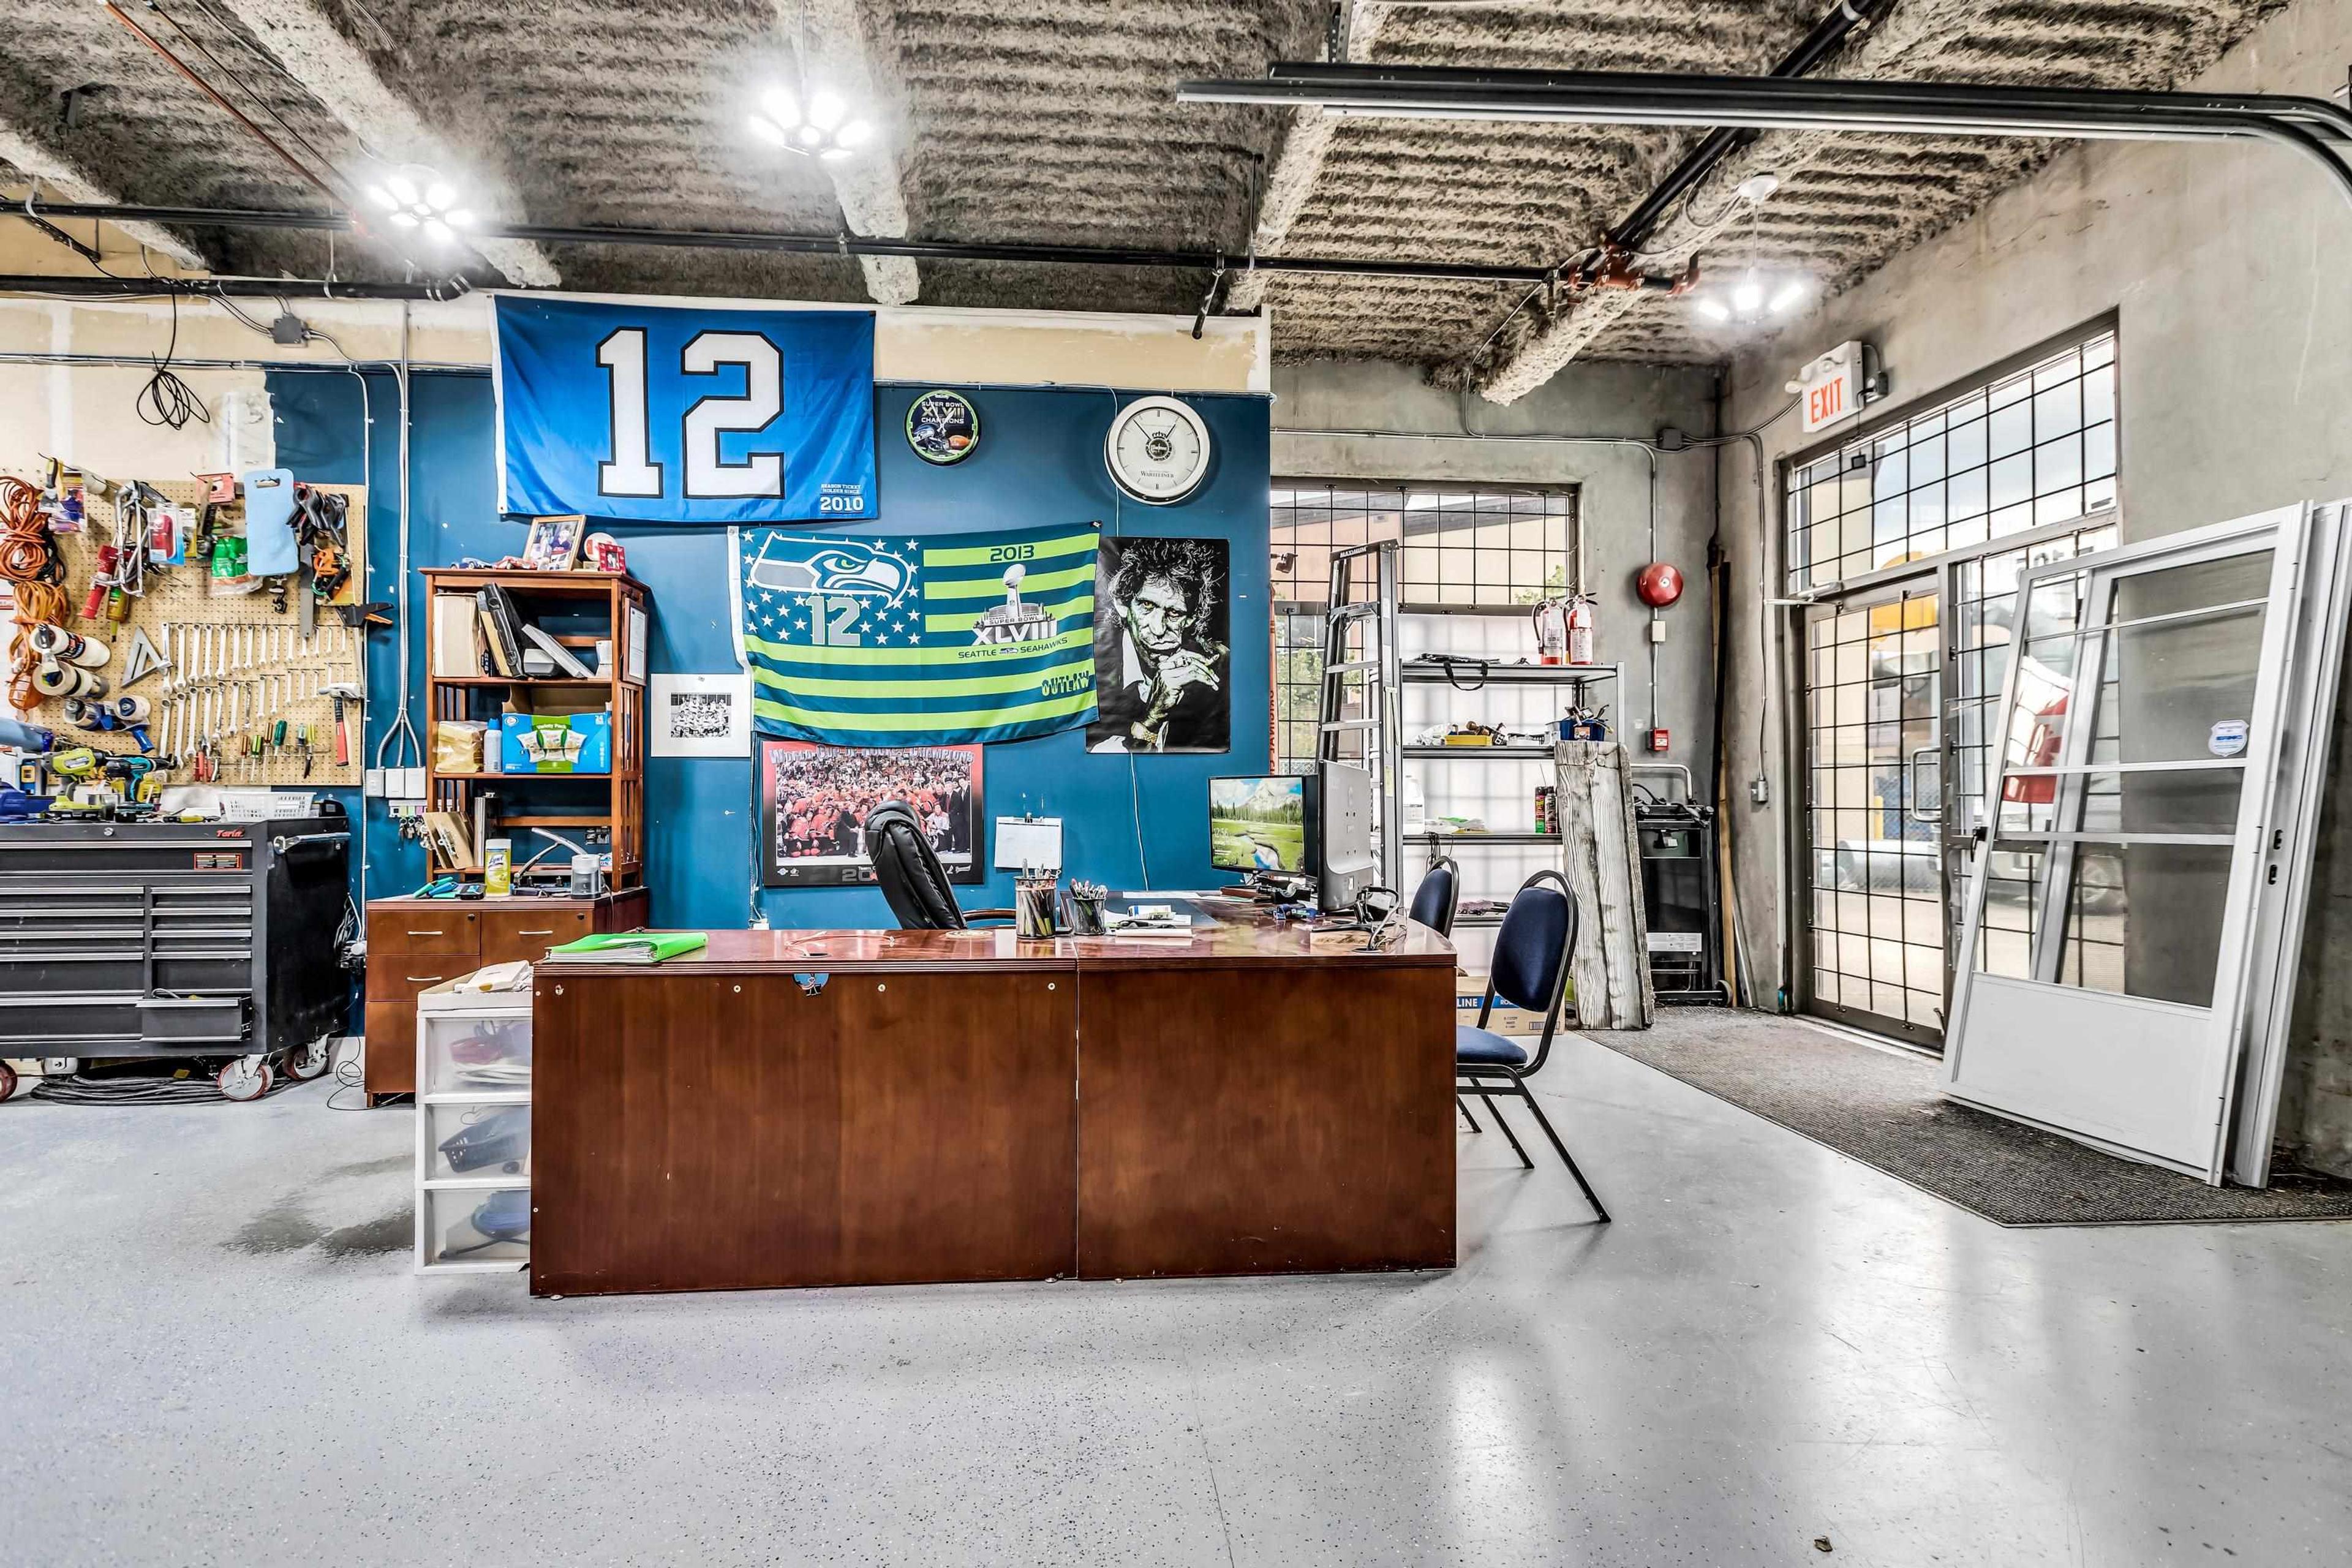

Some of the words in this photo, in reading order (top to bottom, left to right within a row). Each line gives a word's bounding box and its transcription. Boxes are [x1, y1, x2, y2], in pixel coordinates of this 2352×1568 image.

[1811, 376, 1843, 424] EXIT
[595, 326, 785, 499] 12
[820, 496, 864, 511] 2010
[990, 545, 1035, 562] 2013
[805, 595, 861, 647] 12
[971, 619, 1058, 646] XLVIII
[958, 649, 997, 659] SEATTLE
[1020, 637, 1068, 654] SEAHAWKS
[1457, 998, 1478, 1007] LINE
